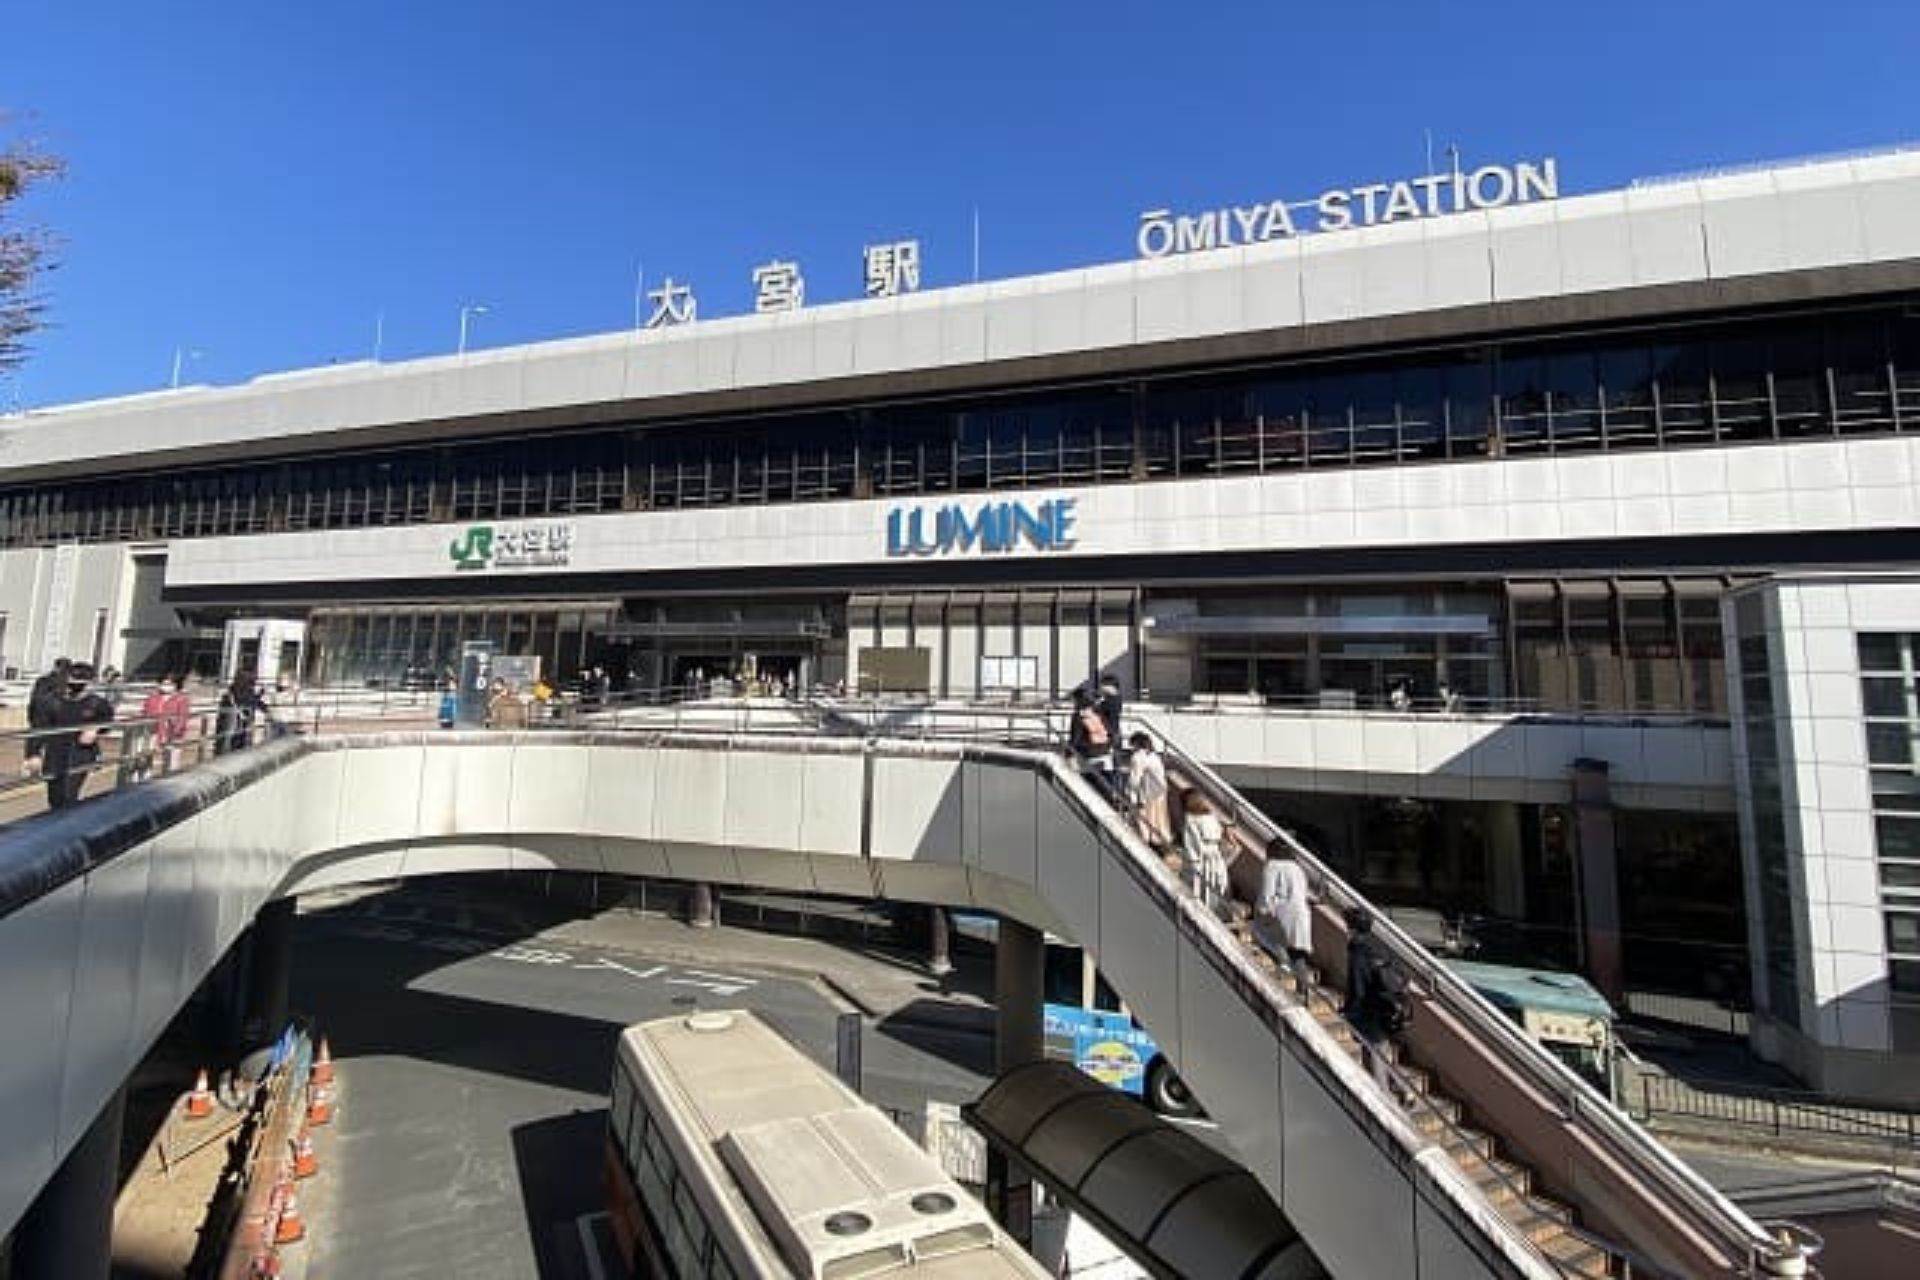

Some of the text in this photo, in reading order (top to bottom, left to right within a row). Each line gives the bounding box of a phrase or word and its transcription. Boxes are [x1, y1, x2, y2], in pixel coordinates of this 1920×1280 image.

[1317, 157, 1559, 231] STATION
[646, 239, 920, 328] 大宮駅
[450, 526, 494, 561] JR
[887, 498, 1079, 557] LUMINE
